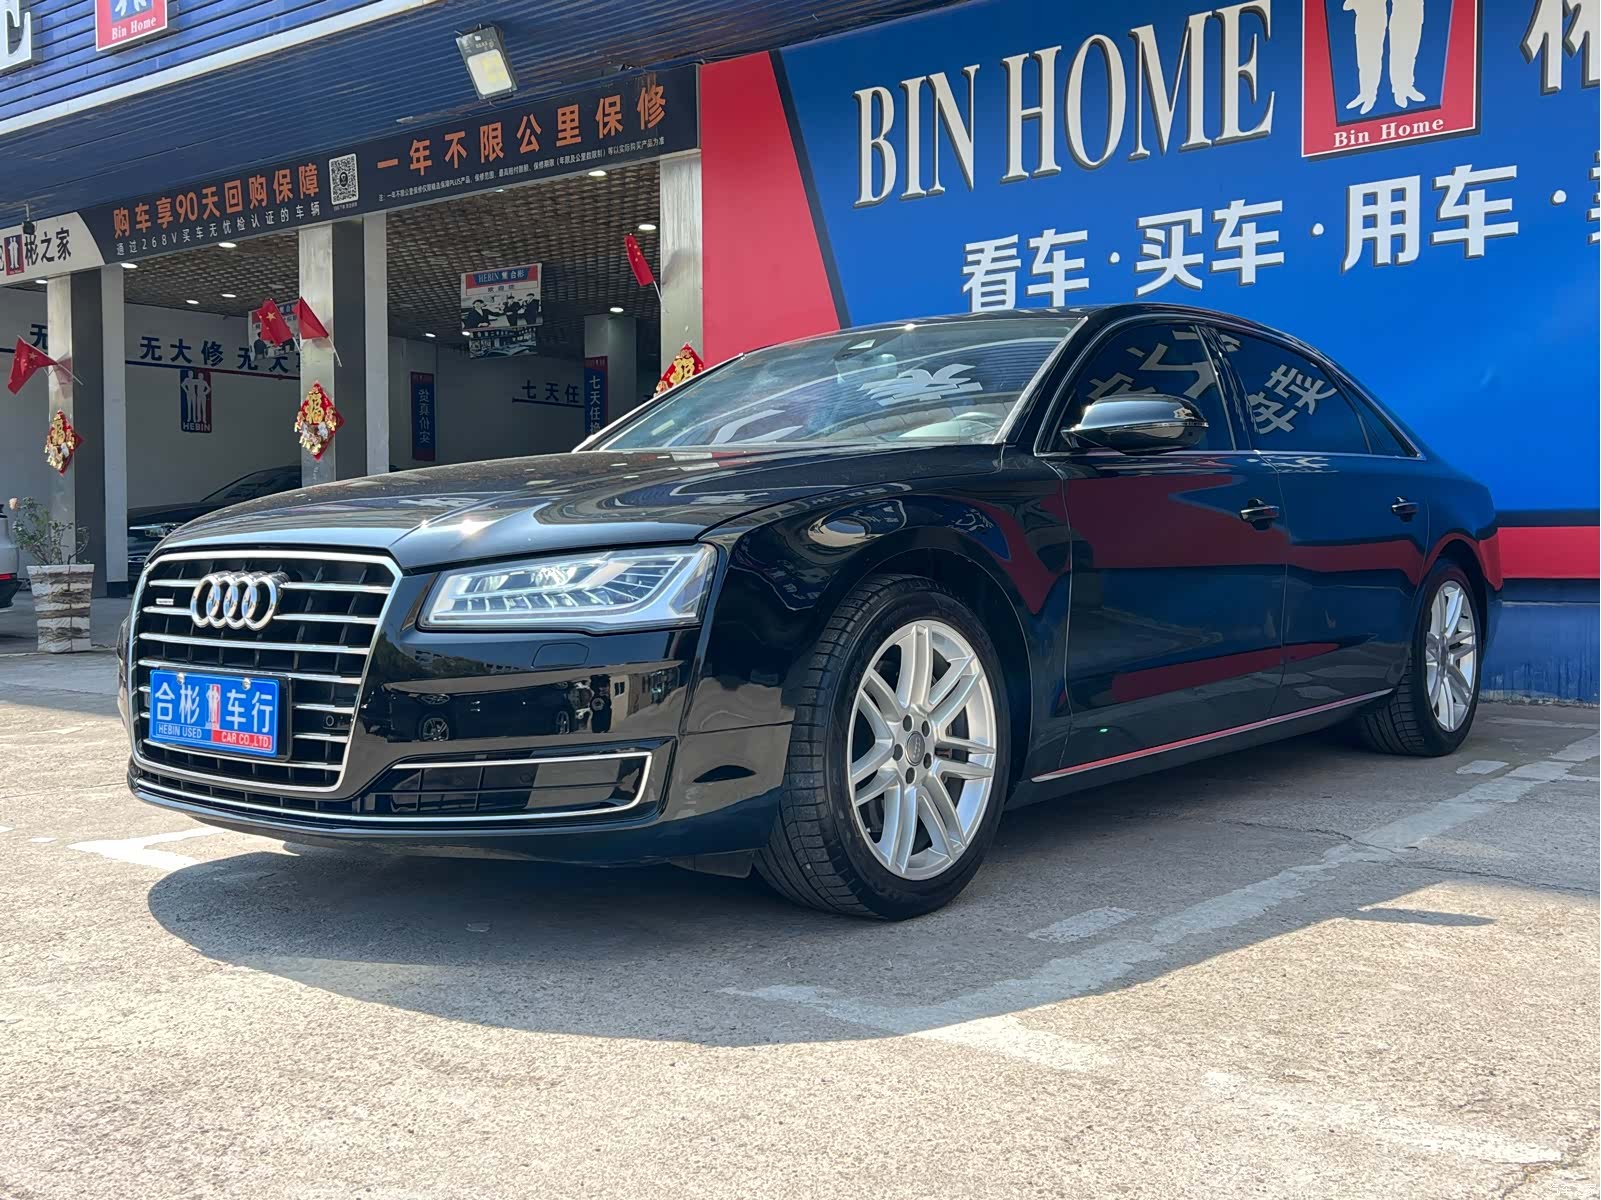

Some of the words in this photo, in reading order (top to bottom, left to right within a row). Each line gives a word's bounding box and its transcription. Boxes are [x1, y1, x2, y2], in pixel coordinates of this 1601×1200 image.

[111, 25, 127, 40] Bin
[131, 17, 157, 33] Home
[853, 64, 981, 207] BIN
[1001, 0, 1276, 182] HOME
[376, 84, 666, 176] 一年不限公里保修
[1333, 129, 1370, 148] Bin
[1380, 118, 1444, 140] Home
[113, 162, 319, 239] 购车享90天回购保障
[116, 201, 320, 256] 通过268V买车无忧检认证的车辆
[140, 336, 224, 367] 无大修
[522, 380, 580, 404] 七天任
[182, 422, 211, 432] HEBIN
[155, 682, 200, 724] 合彬
[225, 689, 273, 733] 车行
[158, 723, 180, 736] HEBIN
[182, 727, 202, 738] USED
[221, 732, 237, 744] CAR
